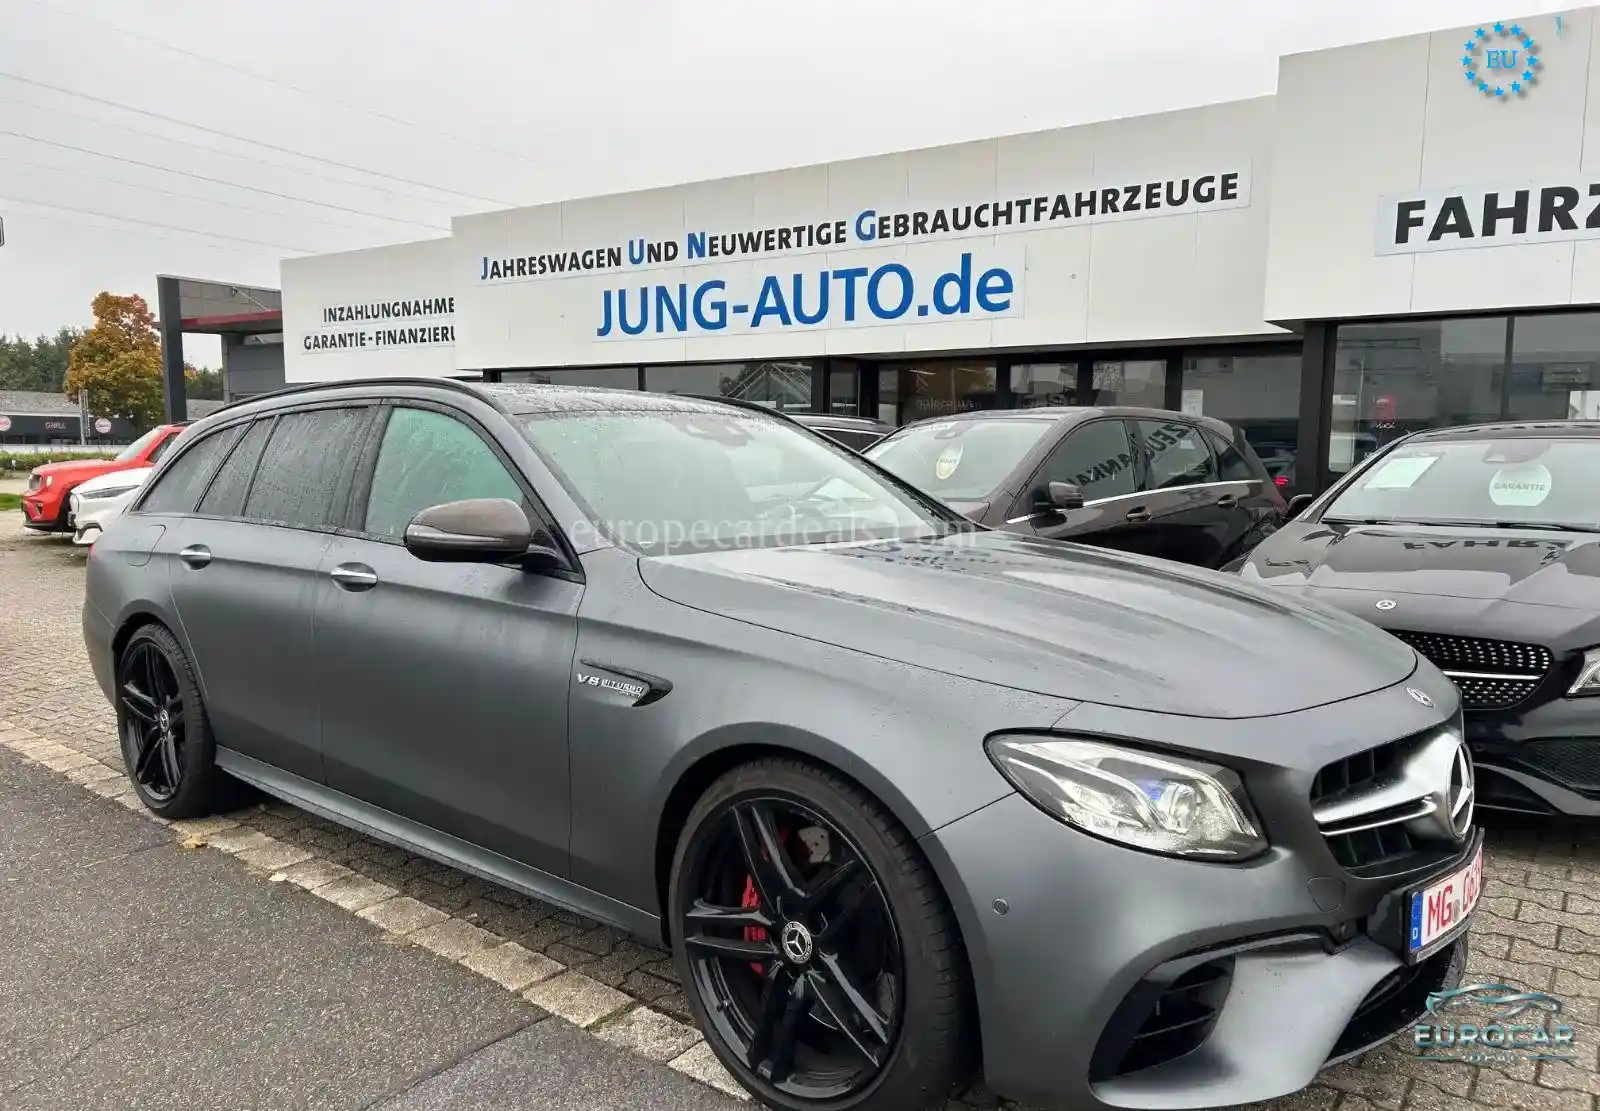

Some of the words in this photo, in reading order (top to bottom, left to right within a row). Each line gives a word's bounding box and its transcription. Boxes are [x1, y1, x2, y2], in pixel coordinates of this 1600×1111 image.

[481, 246, 622, 281] JAHRESWAGEN
[687, 221, 847, 259] NEUWERTIGE
[855, 172, 1239, 241] GEBRAUCHTFAHRZEUGE
[323, 297, 455, 323] INZAHLUNGNAHME
[597, 252, 1014, 337] JUNG-AUTO.de
[577, 673, 600, 686] V8
[1427, 884, 1453, 938] MG
